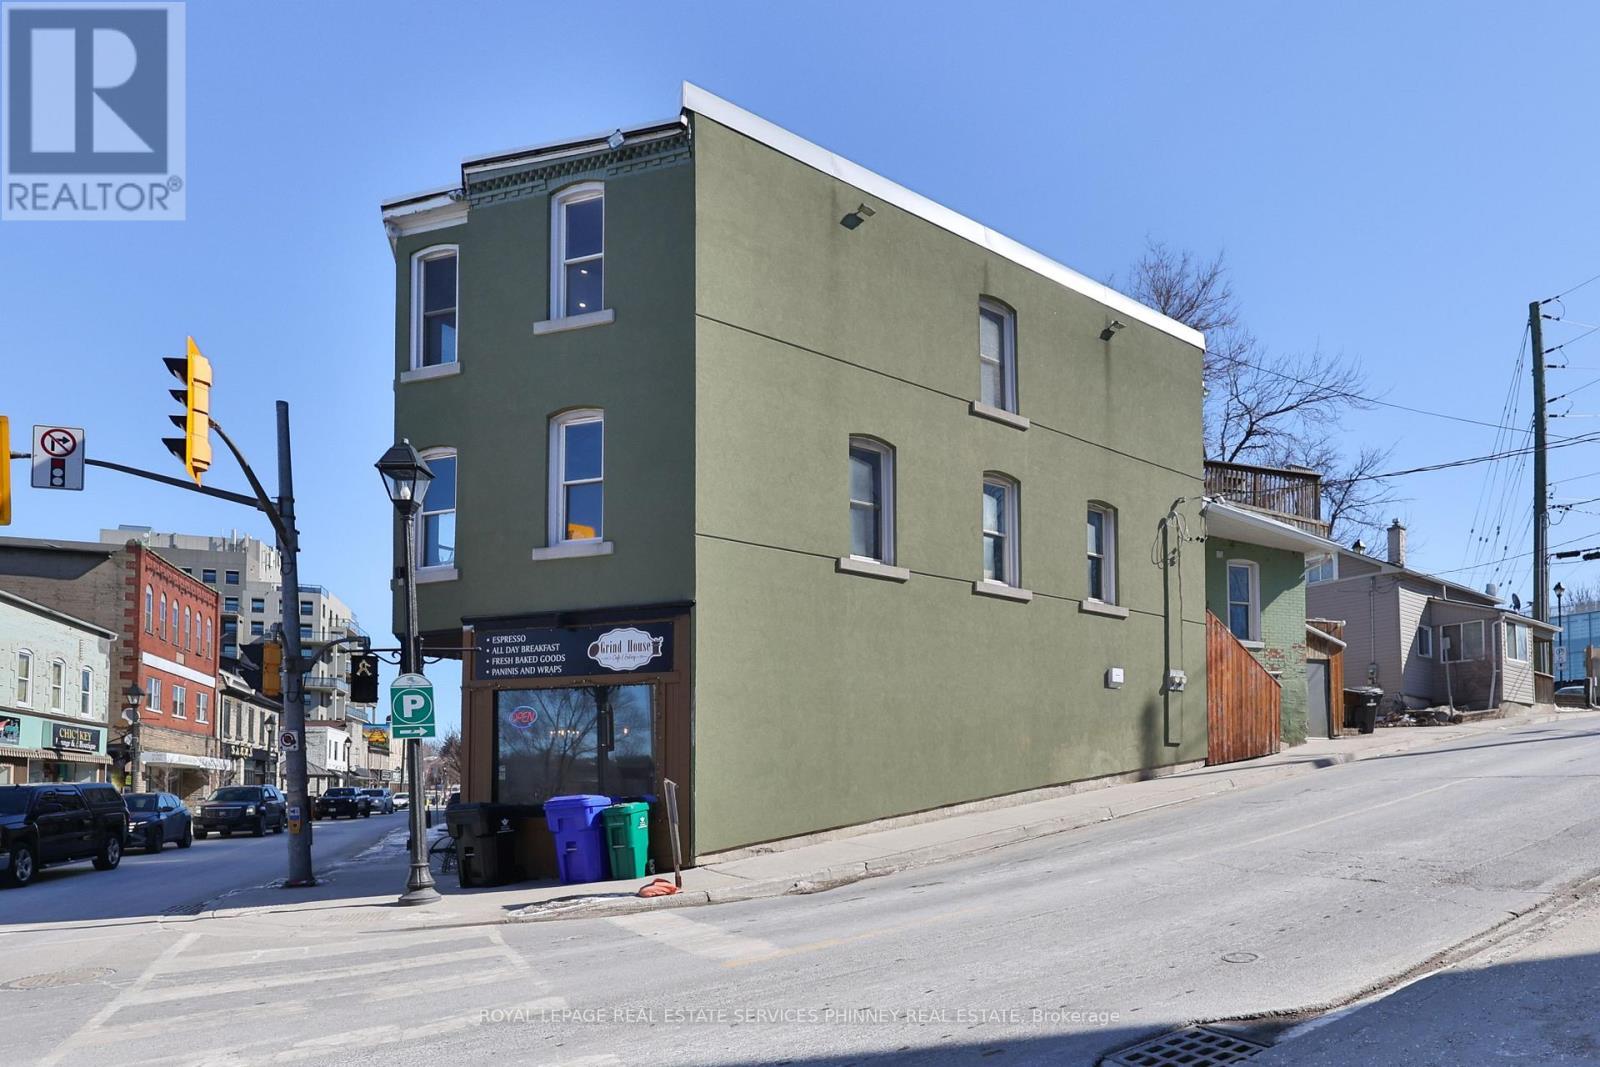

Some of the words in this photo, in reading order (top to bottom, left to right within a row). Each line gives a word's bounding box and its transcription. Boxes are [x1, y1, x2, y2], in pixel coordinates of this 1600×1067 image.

[492, 634, 527, 644] ESPRESSO
[491, 647, 505, 655] ALL
[505, 646, 520, 654] DAY
[521, 643, 561, 653] BREAKFAST
[600, 639, 622, 654] Grind
[627, 639, 651, 653] House
[491, 656, 514, 665] FRESH
[515, 655, 539, 664] BAKED
[540, 654, 566, 663] GOODS
[491, 667, 519, 676] PANINIS
[520, 666, 536, 675] AND
[537, 665, 563, 674] WRAPS
[403, 694, 425, 718] P
[512, 711, 536, 723] OPEN
